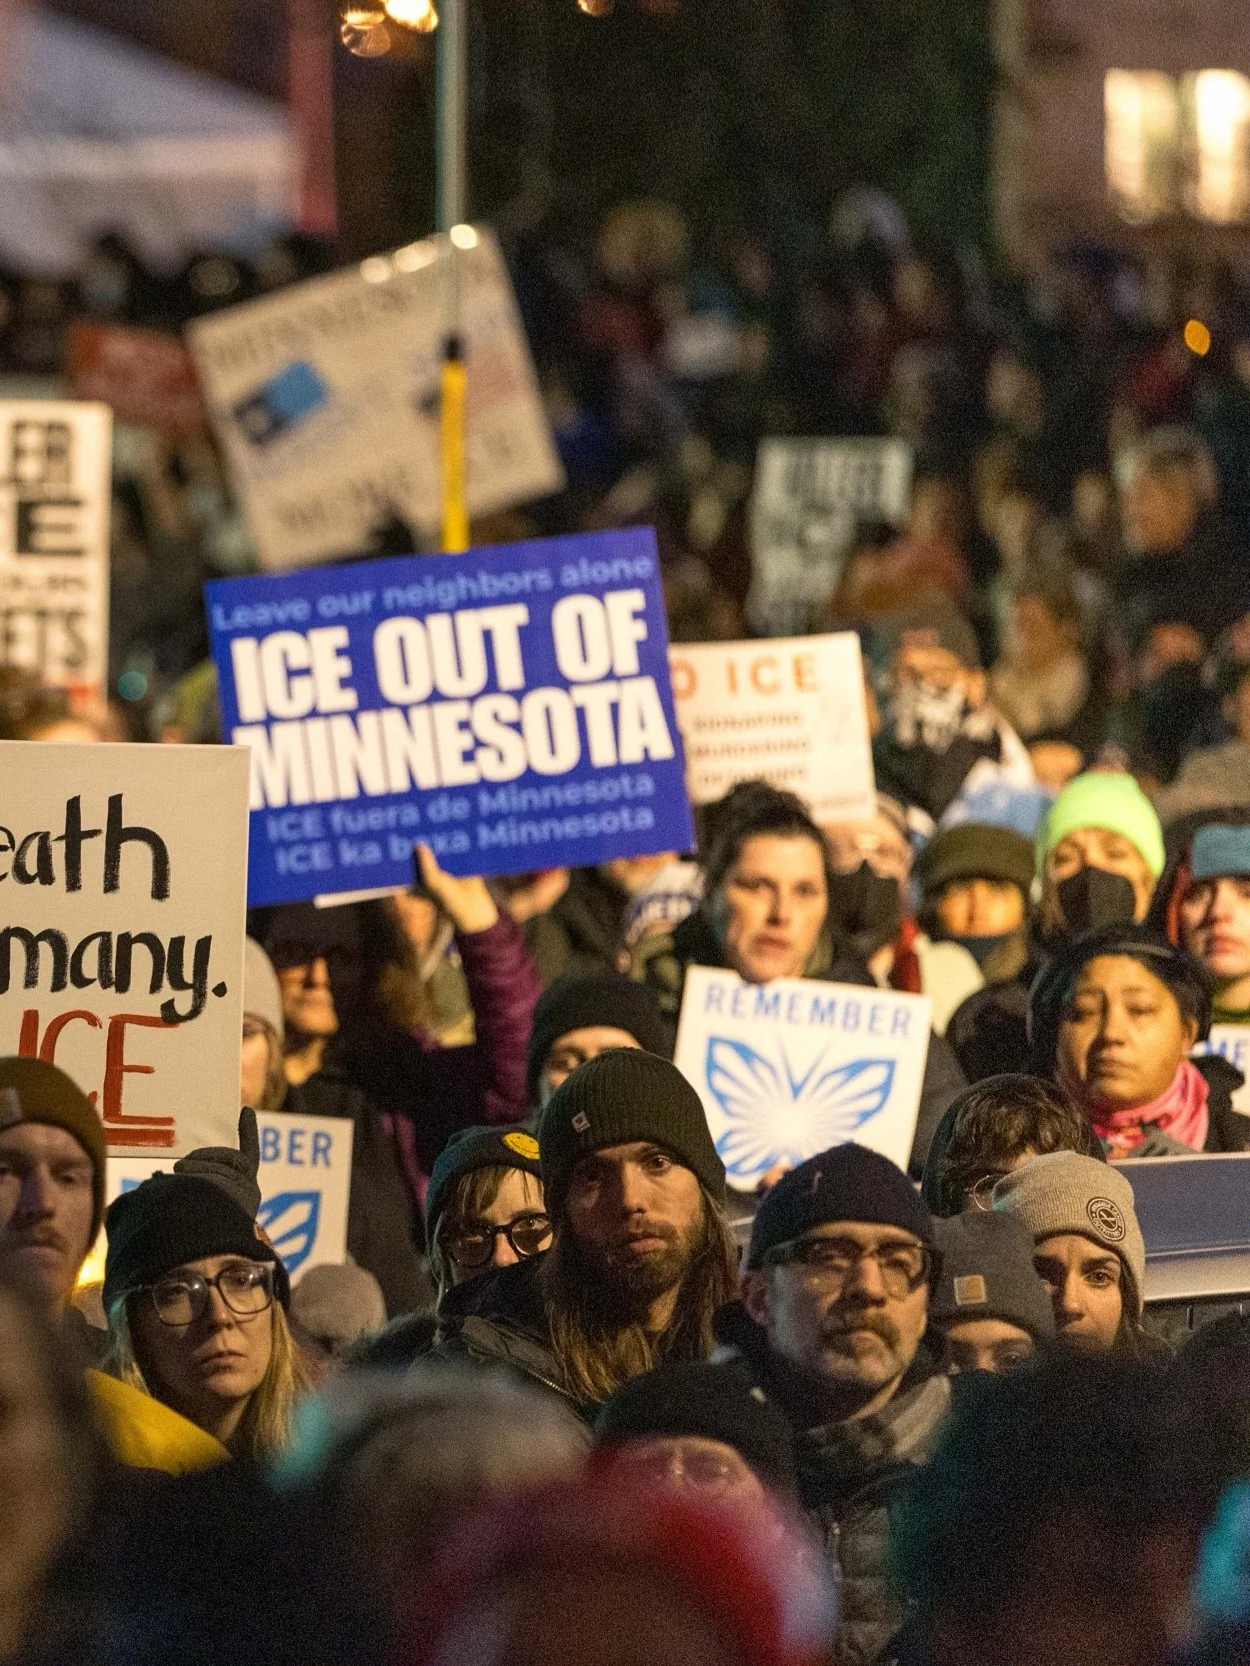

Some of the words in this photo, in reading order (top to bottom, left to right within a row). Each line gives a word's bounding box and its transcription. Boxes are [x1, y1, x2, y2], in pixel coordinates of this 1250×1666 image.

[213, 598, 312, 631] Leave
[317, 588, 376, 618] our
[383, 563, 552, 610] neighbors
[560, 553, 654, 586] alone
[230, 625, 358, 724] ICE
[372, 602, 530, 706] OUT
[550, 588, 649, 683] OF
[725, 653, 820, 697] ICE
[231, 675, 676, 811] MINNESOTA
[266, 812, 324, 843] ICE
[330, 799, 421, 835] fuera
[427, 791, 471, 821] de
[478, 772, 655, 815] Minnesota
[275, 843, 333, 875] ICE
[340, 836, 382, 866] ka
[478, 806, 655, 849] Minnesota
[704, 983, 912, 1037] REMEMBER
